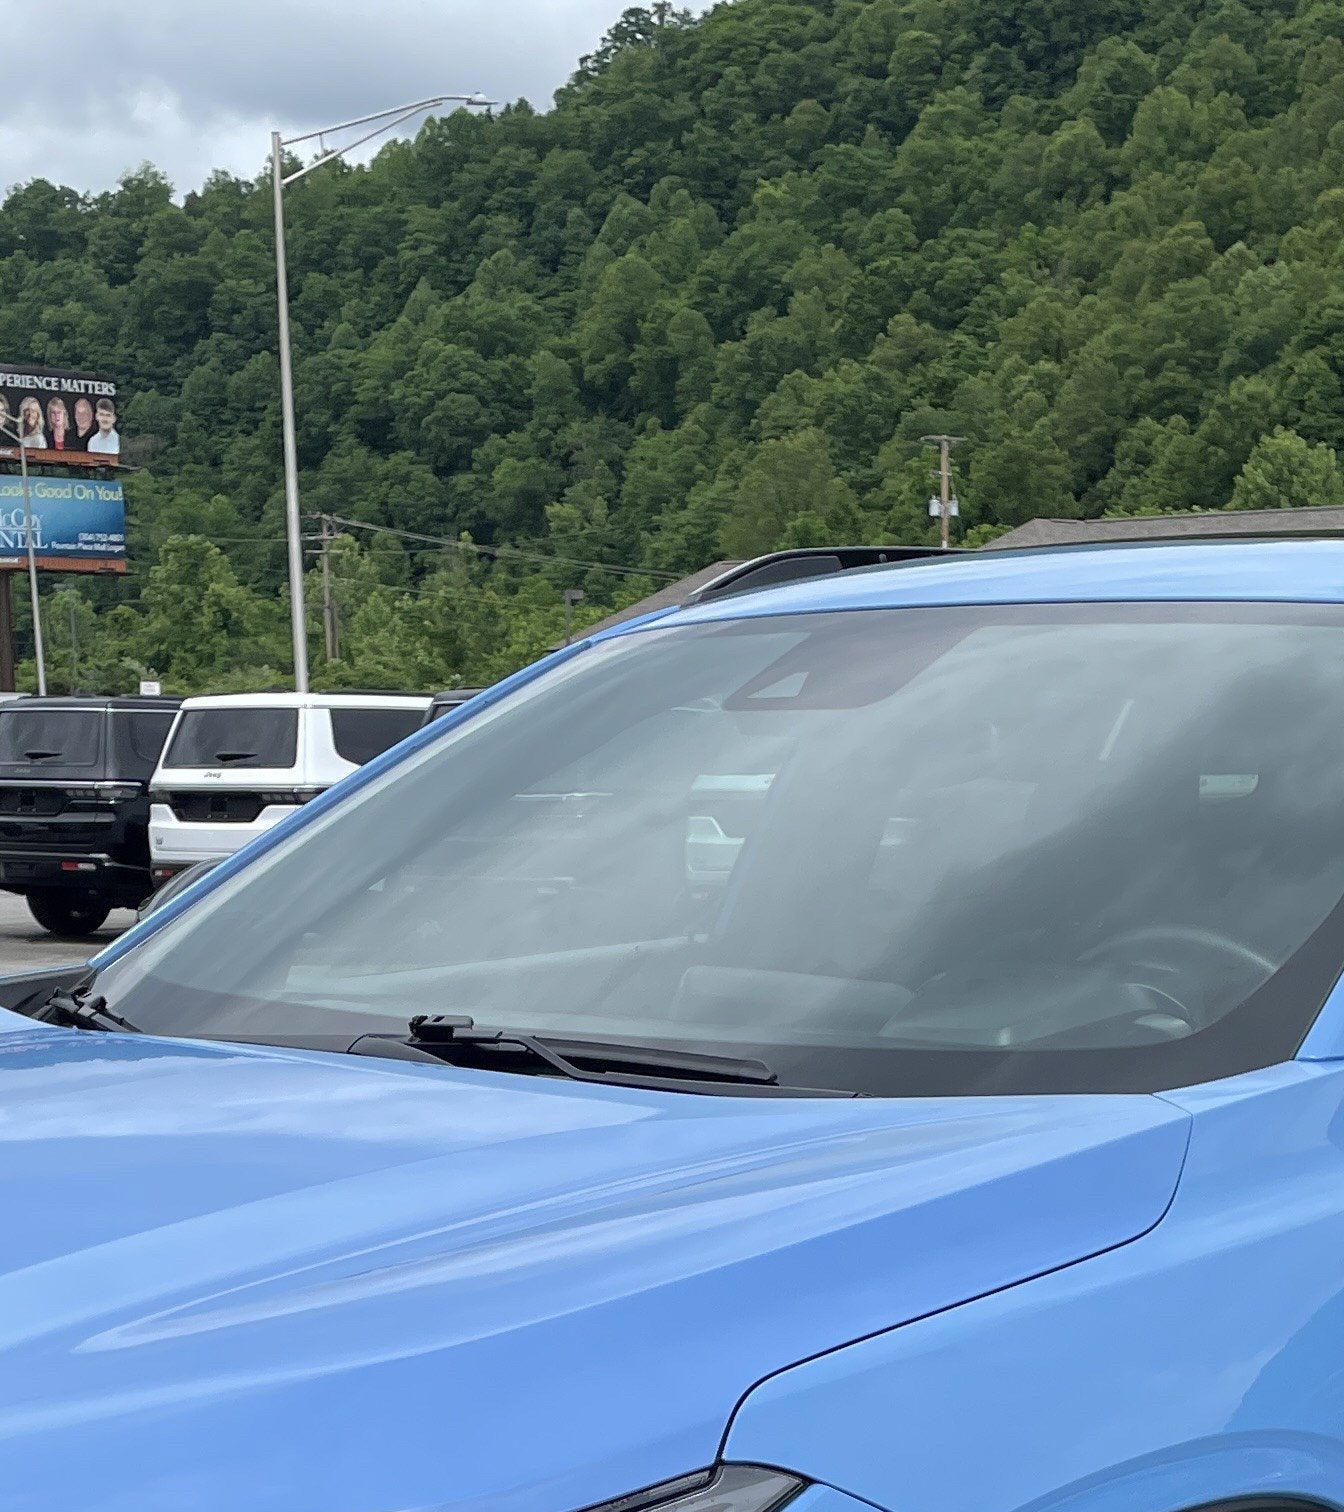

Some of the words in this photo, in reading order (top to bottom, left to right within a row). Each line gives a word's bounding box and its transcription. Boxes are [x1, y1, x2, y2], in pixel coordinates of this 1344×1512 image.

[60, 378, 116, 396] MATTERS
[35, 482, 72, 499] Good
[74, 484, 94, 501] On
[95, 485, 123, 501] You!
